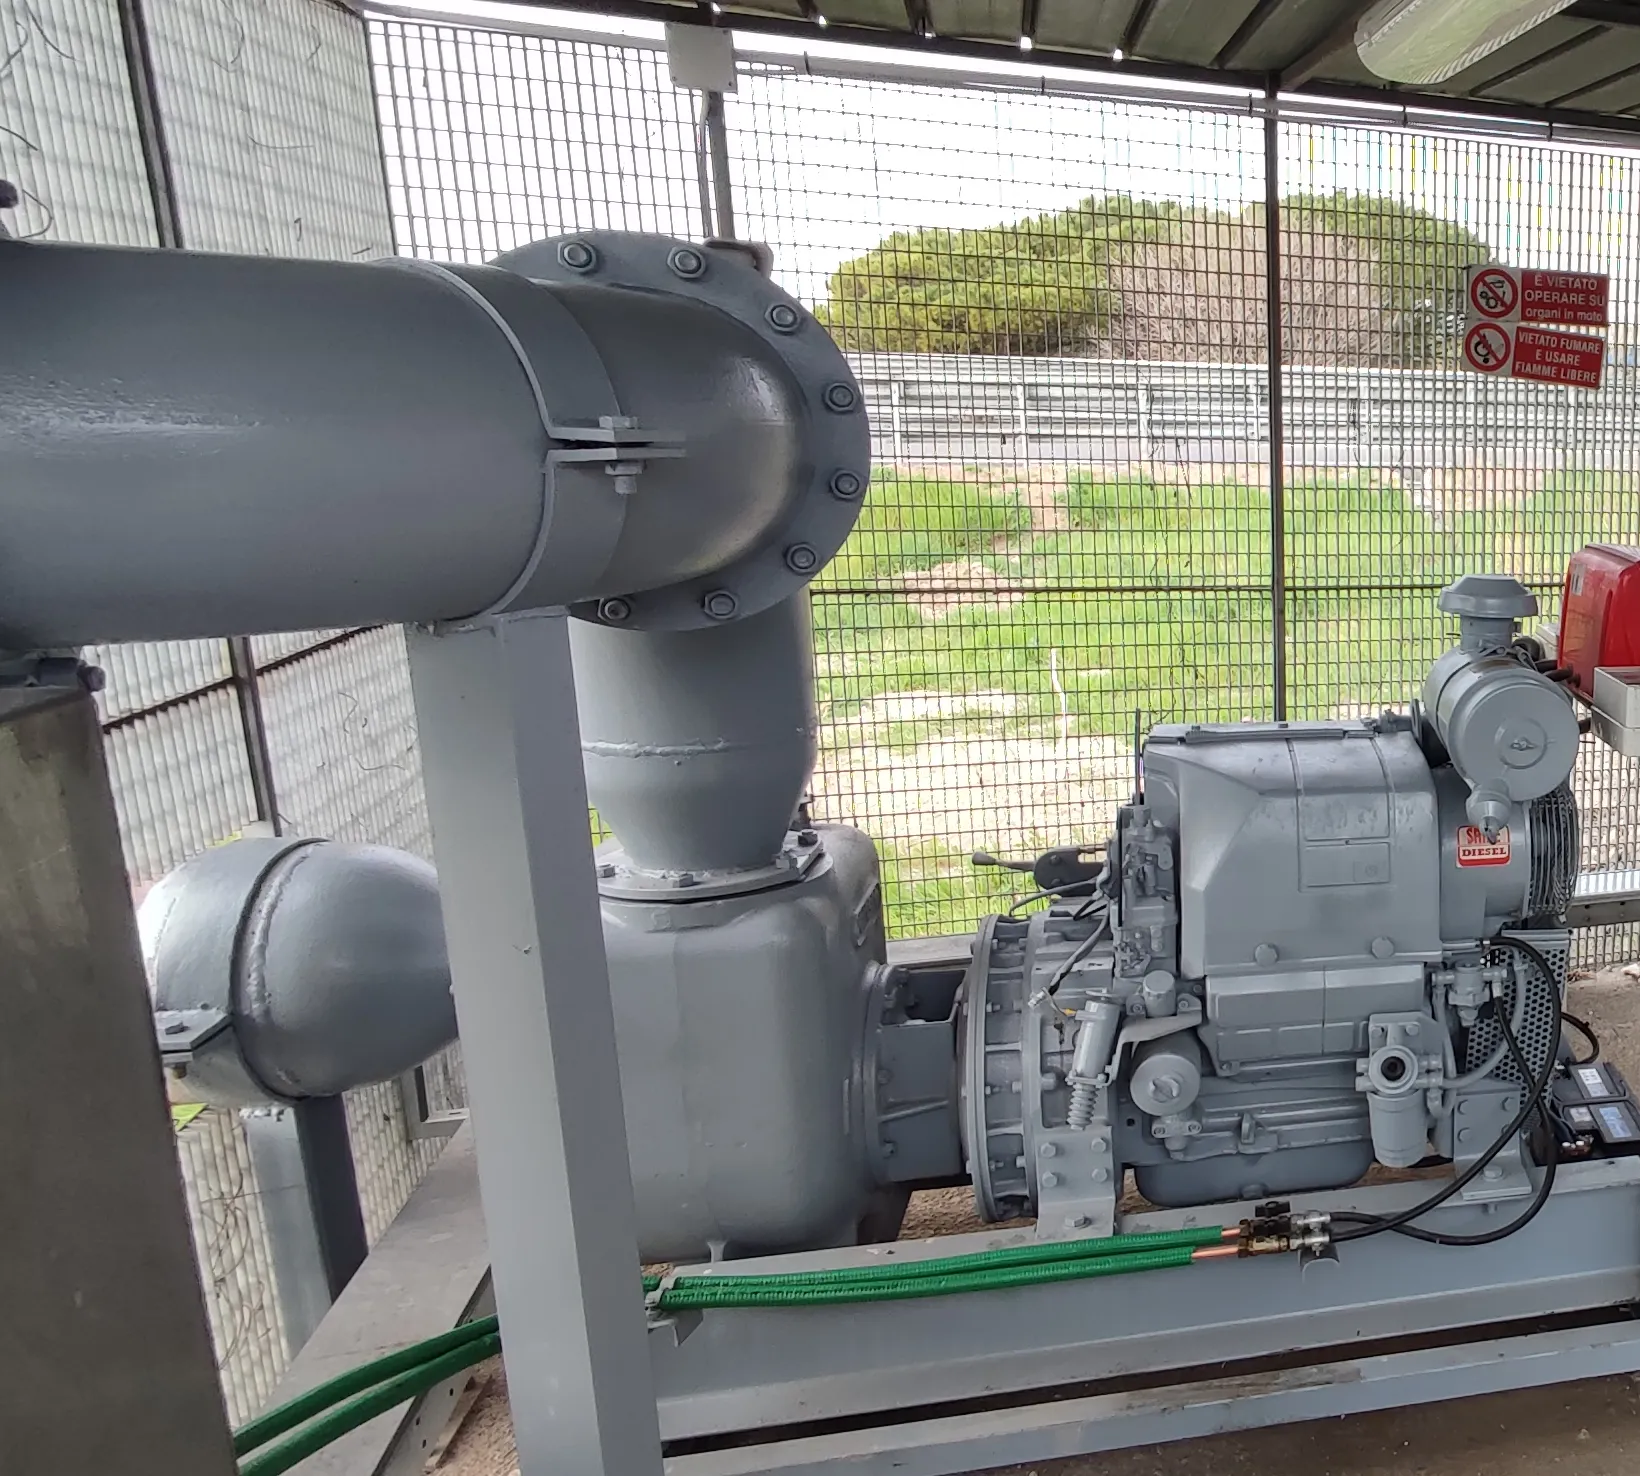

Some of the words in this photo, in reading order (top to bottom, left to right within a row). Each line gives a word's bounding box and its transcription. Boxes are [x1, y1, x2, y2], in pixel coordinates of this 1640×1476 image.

[1547, 275, 1598, 291] VIETATO
[1524, 289, 1586, 305] OPERARE
[1589, 294, 1605, 307] SU
[1525, 307, 1561, 321] organi
[1564, 308, 1574, 320] in
[1577, 310, 1603, 322] moto
[1518, 331, 1558, 348] VIETATO
[1560, 338, 1600, 355] FUMARE
[1536, 349, 1542, 361] E
[1545, 351, 1581, 367] USARE
[1515, 361, 1558, 378] FIAMME
[1561, 368, 1597, 384] LIBERE
[1462, 847, 1507, 857] DIESEL
